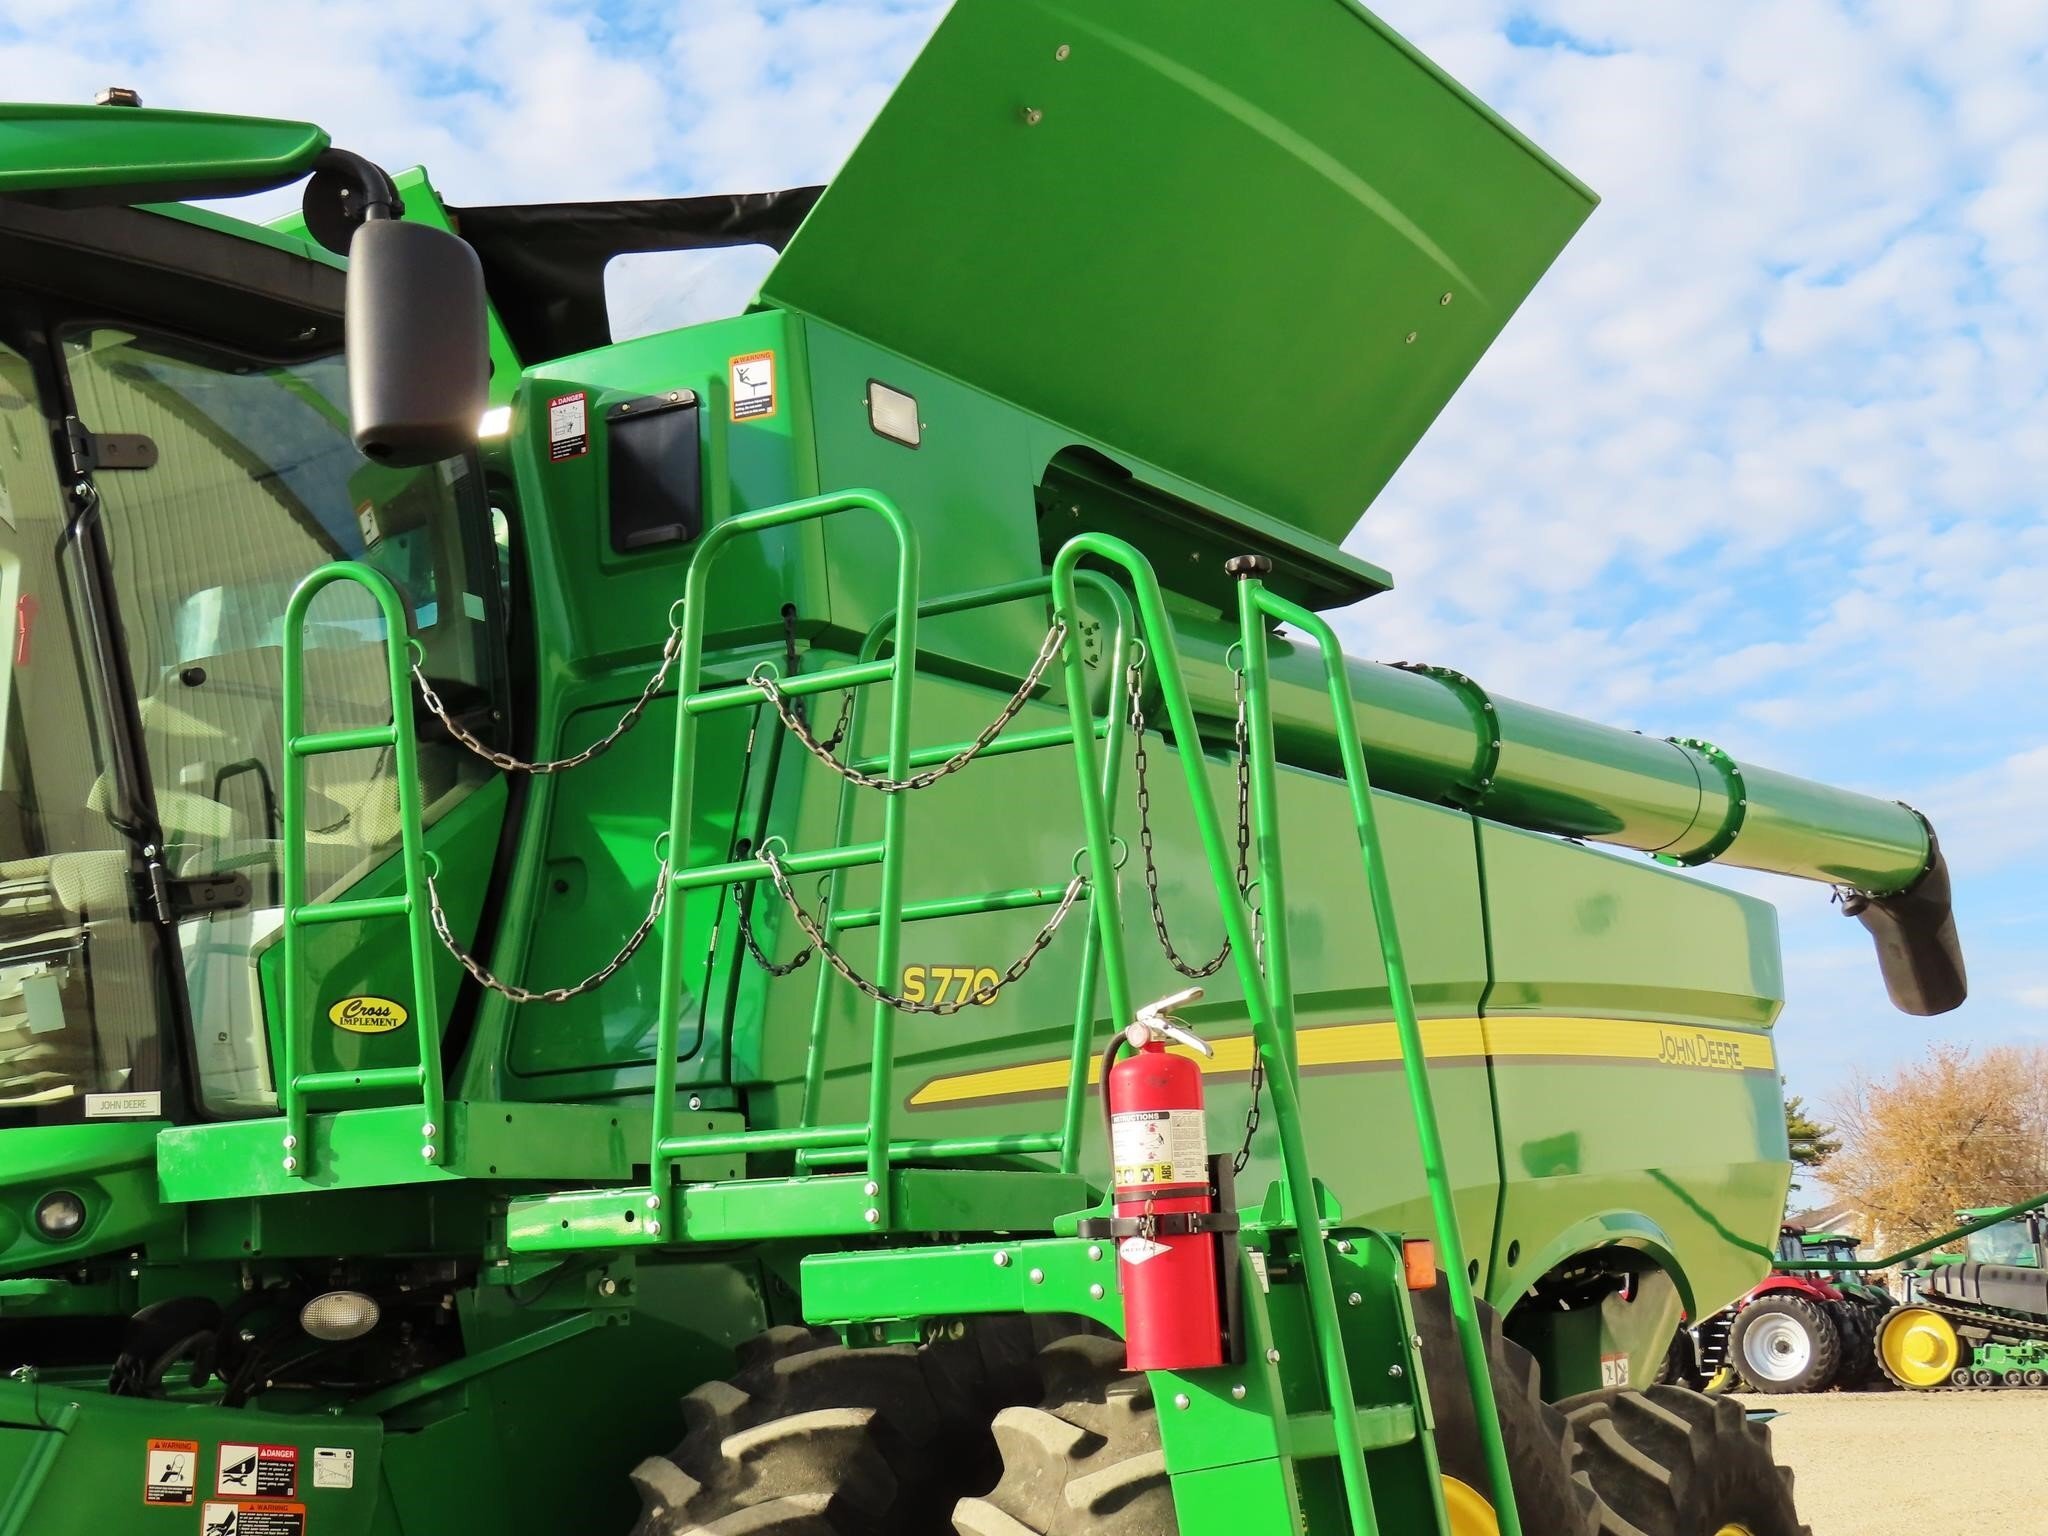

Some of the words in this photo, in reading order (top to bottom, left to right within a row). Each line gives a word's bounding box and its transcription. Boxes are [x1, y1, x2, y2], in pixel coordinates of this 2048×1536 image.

[740, 352, 770, 362] WARNING
[558, 393, 584, 405] DANGER
[343, 999, 392, 1018] Cross
[340, 1017, 398, 1026] IMPLEMENT
[1658, 1030, 1696, 1062] JOHN
[1696, 1034, 1742, 1066] DEERE
[100, 1100, 121, 1110] JOHN
[124, 1099, 147, 1109] DEERE
[1161, 1165, 1172, 1180] ABC
[161, 1441, 192, 1450] WARNING
[266, 1449, 294, 1458] DANGER
[257, 1504, 288, 1512] WARNING
